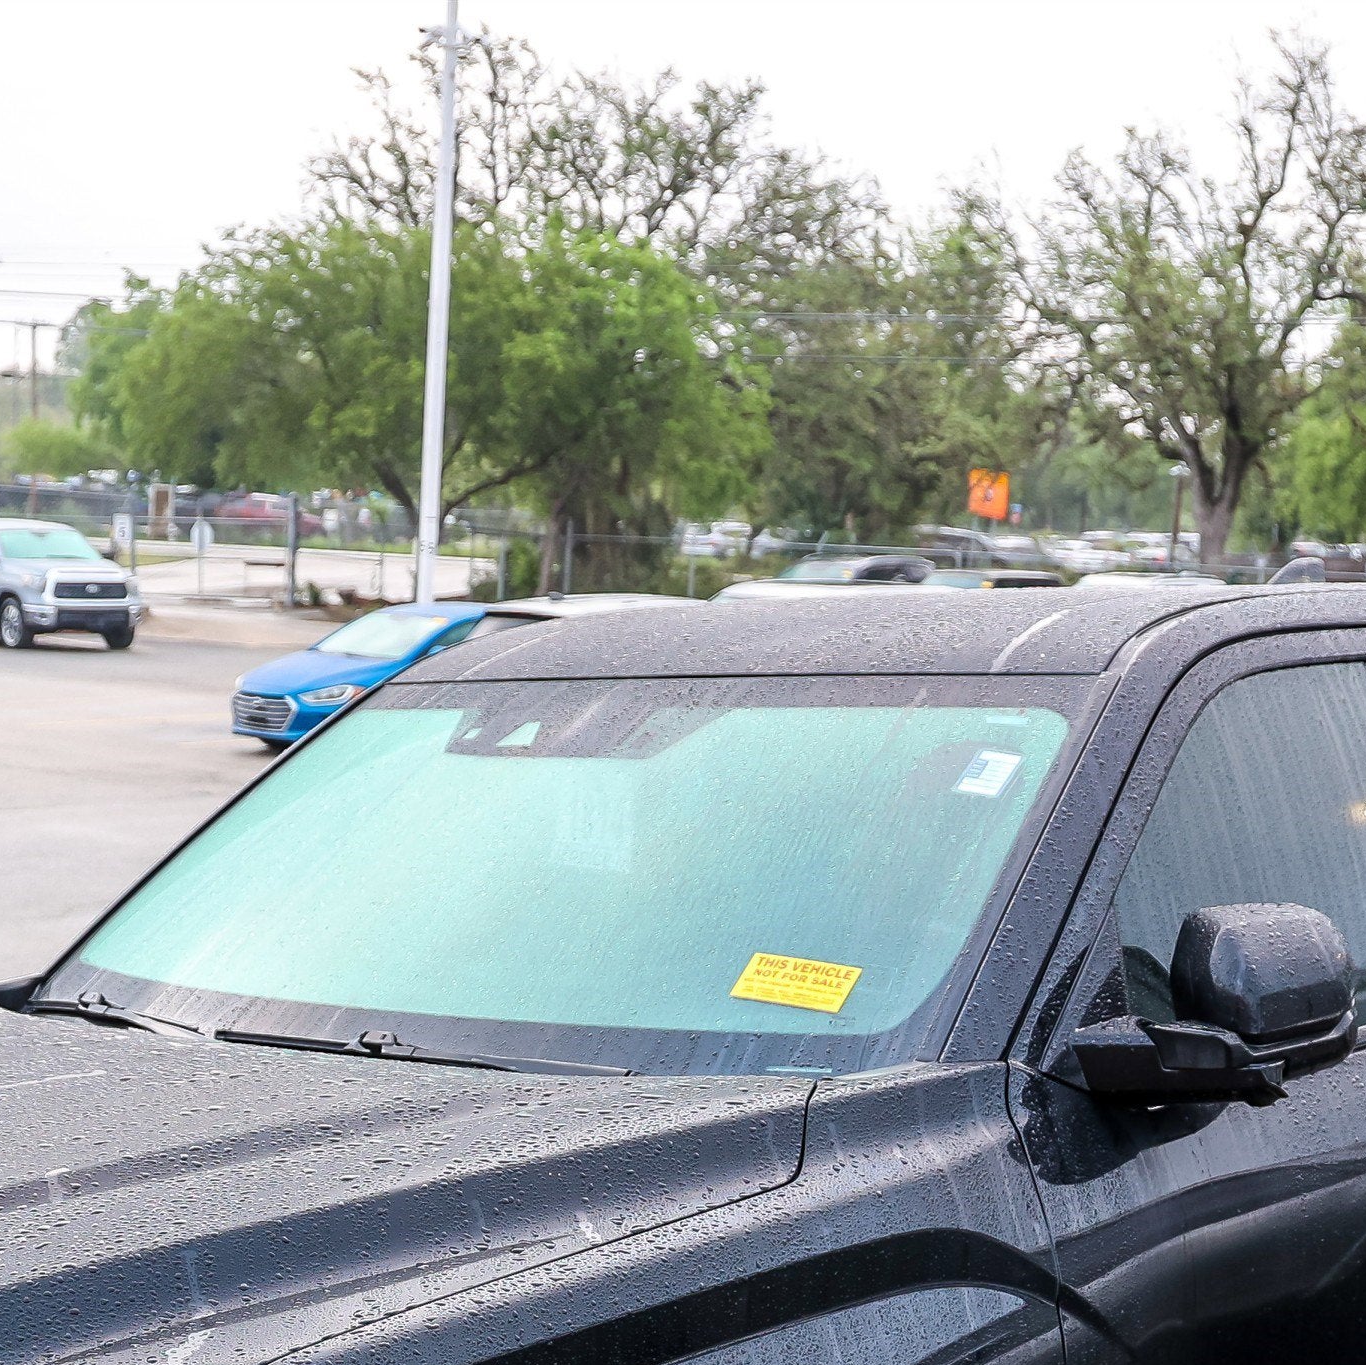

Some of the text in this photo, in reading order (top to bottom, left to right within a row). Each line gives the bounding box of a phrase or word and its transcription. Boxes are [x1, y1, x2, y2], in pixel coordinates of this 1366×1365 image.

[754, 968, 778, 978] NOT
[781, 972, 808, 984] FOR
[811, 977, 845, 989] SALE
[757, 956, 855, 981] THIS VEHICLE
